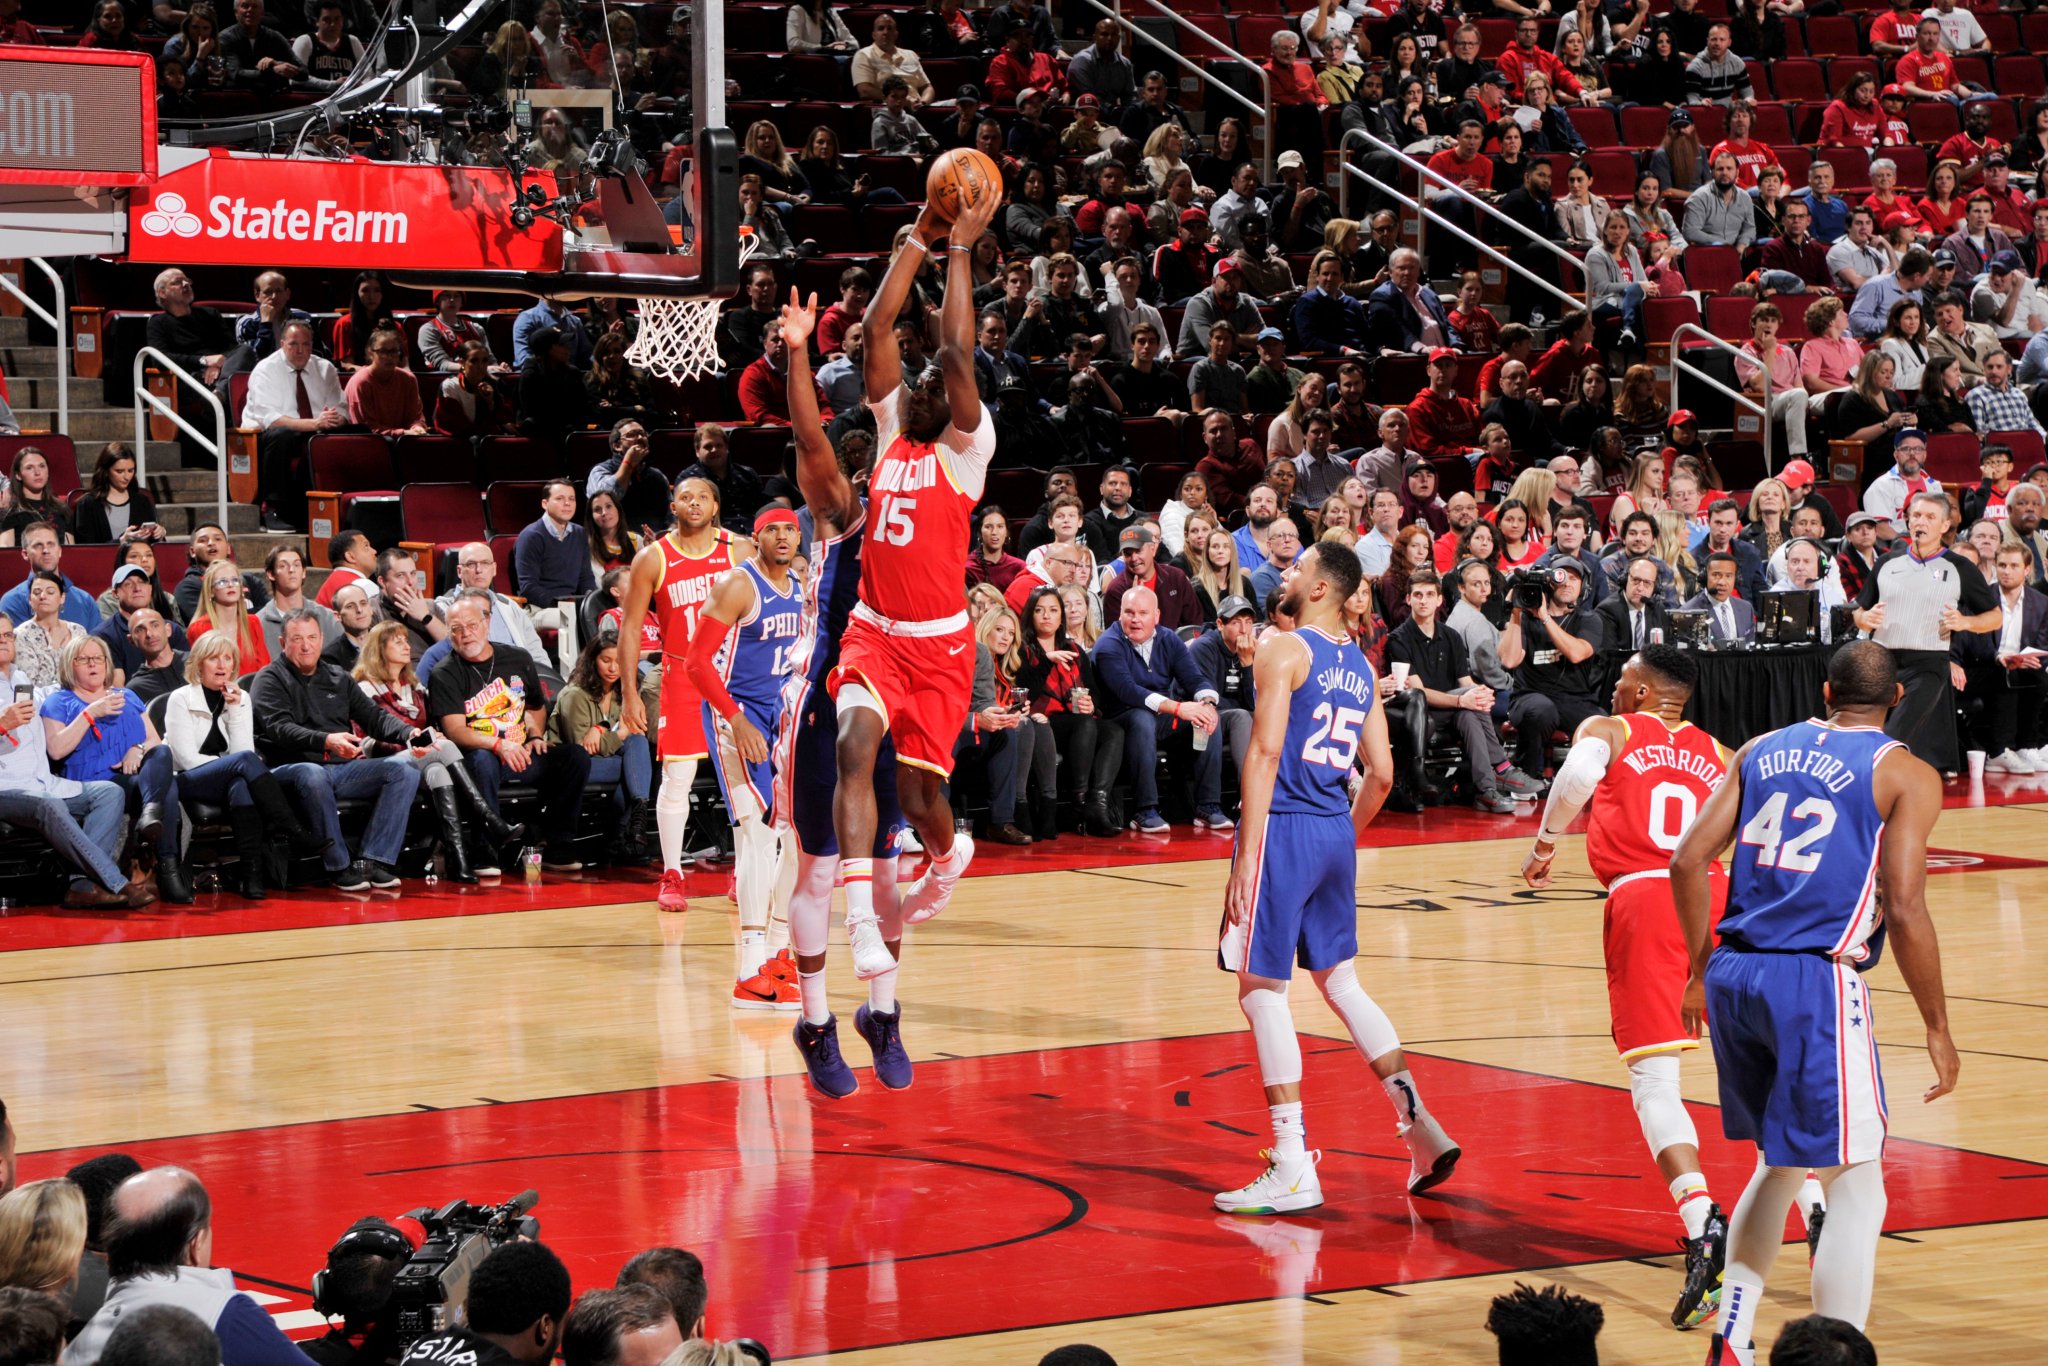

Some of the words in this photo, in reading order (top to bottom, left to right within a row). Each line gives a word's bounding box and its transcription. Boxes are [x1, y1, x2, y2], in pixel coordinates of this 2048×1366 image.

[0, 91, 74, 156] om
[956, 156, 981, 200] SPALDIN
[873, 493, 917, 547] 15
[684, 606, 702, 642] 1
[464, 677, 504, 716] CLUTCH
[1317, 663, 1370, 706] SIMMONS
[1302, 701, 1366, 771] 25
[1623, 745, 1726, 792] WESTBROOK
[1757, 749, 1856, 794] HORFORD
[1648, 781, 1698, 851] 0
[1740, 791, 1838, 874] 42
